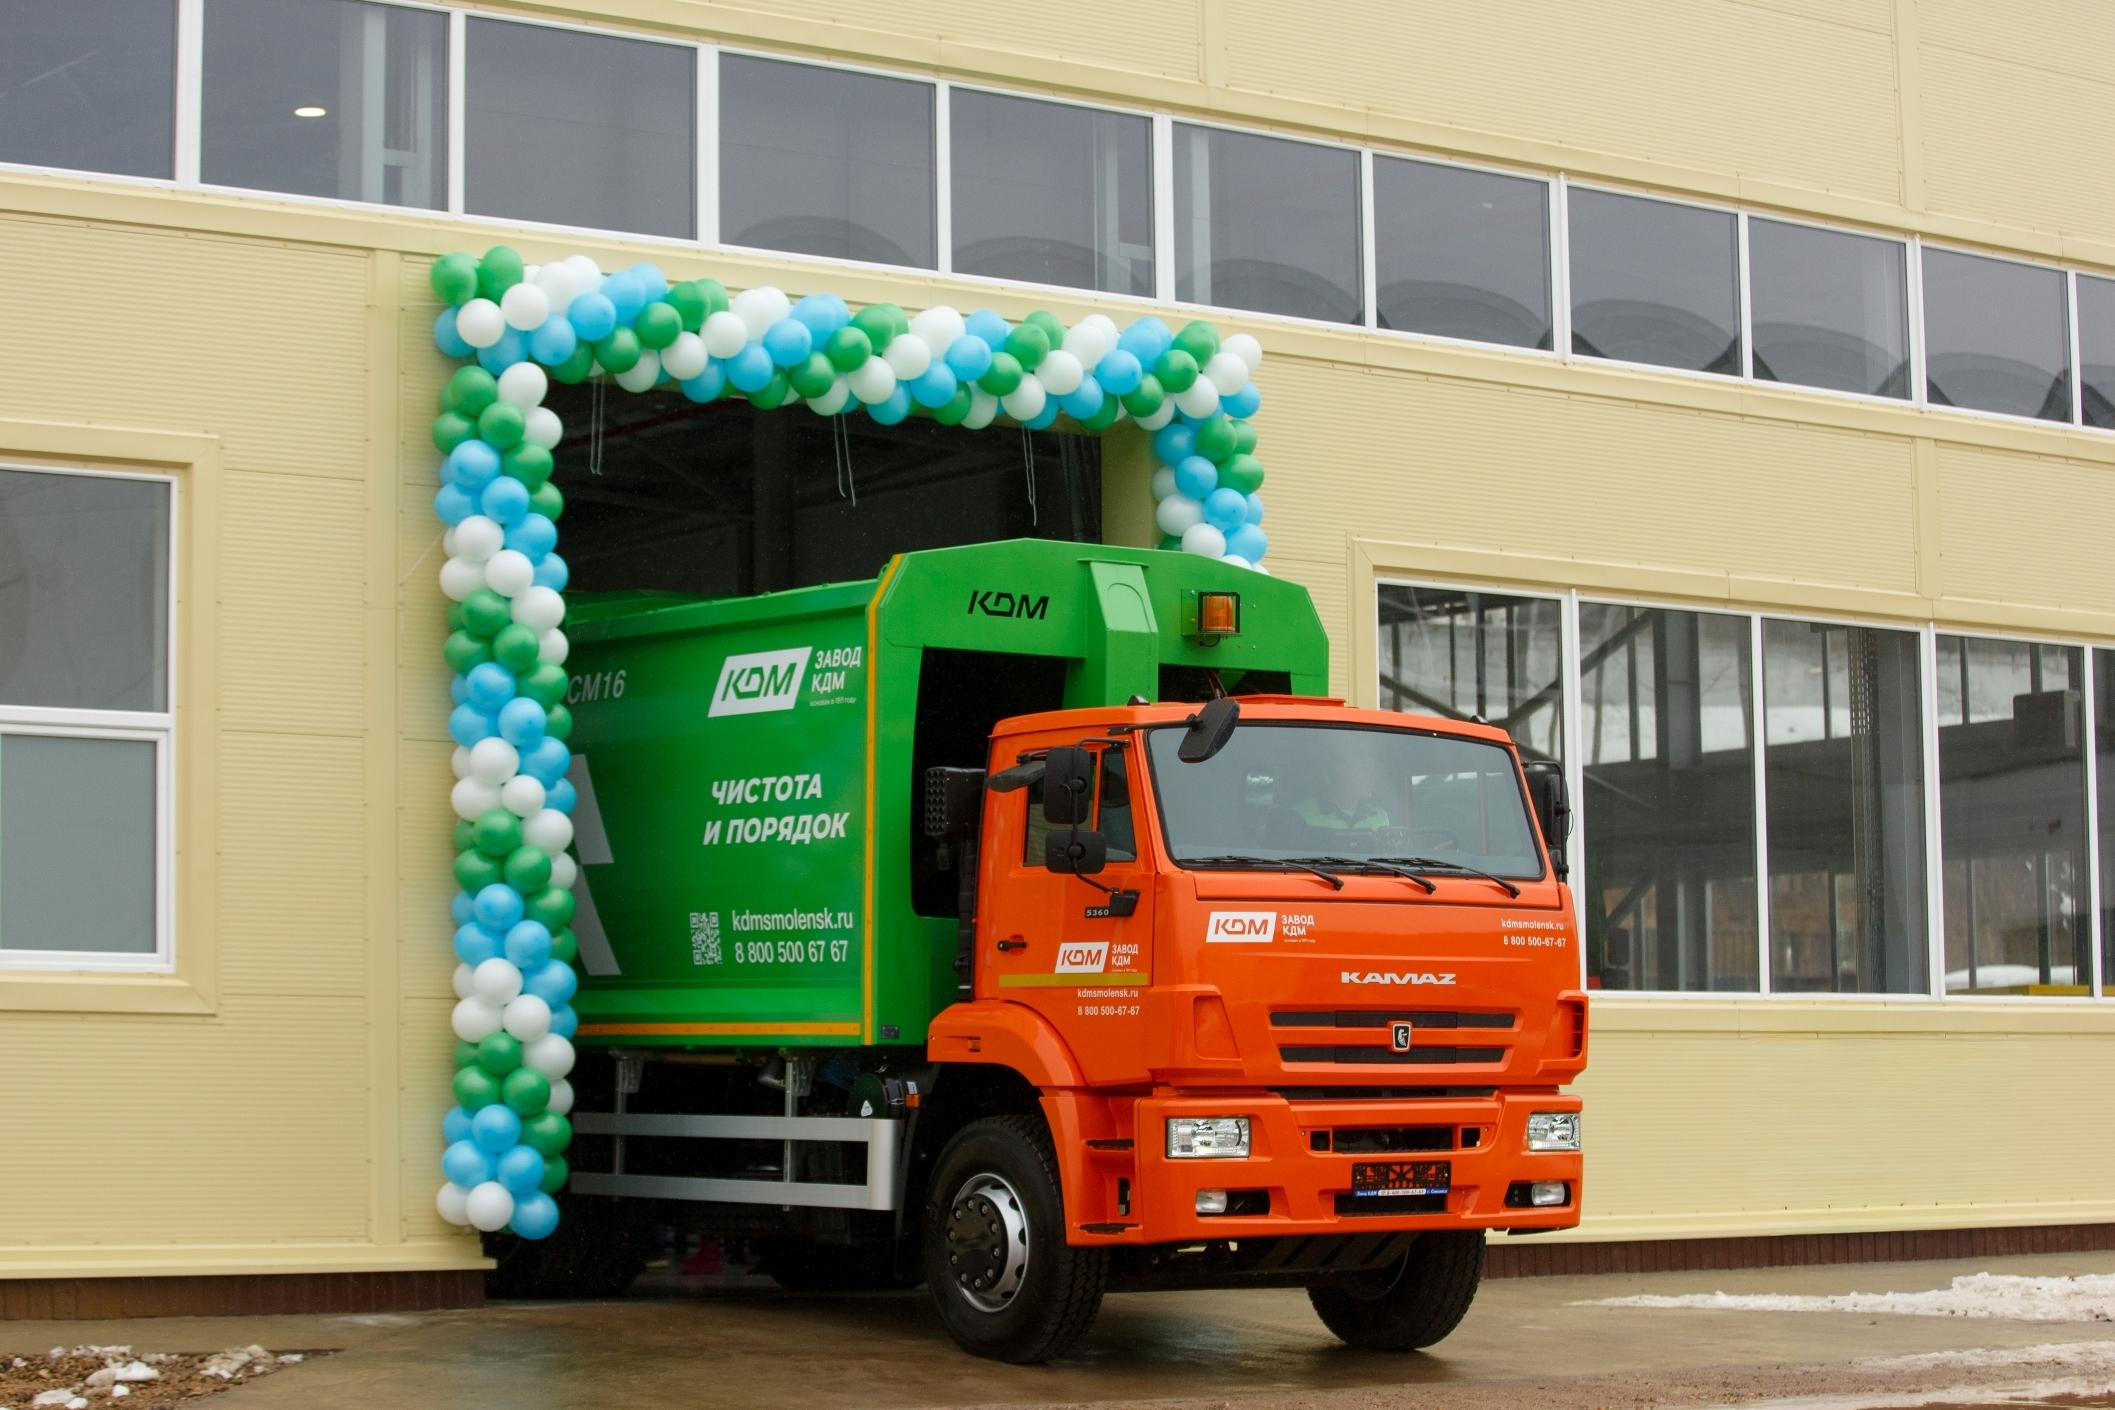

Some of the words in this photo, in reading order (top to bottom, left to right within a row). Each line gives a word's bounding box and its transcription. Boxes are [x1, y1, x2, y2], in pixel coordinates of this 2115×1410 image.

[967, 590, 1050, 620] KDM
[814, 646, 862, 669] ЗАВОД
[721, 661, 798, 702] KDM
[811, 671, 845, 694] КДМ
[711, 773, 822, 805] ЧИСТОТА
[702, 820, 722, 846] И
[725, 812, 850, 845] ПОРЯДОК
[731, 907, 853, 931] kdmsmolensk.ru
[1086, 909, 1109, 917] 5360
[1281, 914, 1315, 926] ЗАВОД
[1214, 918, 1269, 936] KDM
[1282, 925, 1306, 937] КДМ
[1501, 918, 1564, 931] kdmsmolensk.ru
[1112, 944, 1139, 955] ЗАВОД
[1503, 935, 1509, 946] 8
[1510, 935, 1526, 946] 800
[1527, 936, 1567, 948] 500-67-67
[734, 942, 744, 963] 8
[747, 941, 774, 963] 800
[777, 941, 804, 963] 500
[807, 940, 826, 962] 67
[830, 940, 849, 962] 67
[1061, 948, 1103, 967] KDM
[1111, 955, 1131, 966] КДМ
[1340, 971, 1457, 986] KAMAZ
[1077, 988, 1139, 998] kdmsmolensk.ru
[1077, 1006, 1083, 1016] 8
[1084, 1006, 1099, 1016] 800
[1100, 1005, 1140, 1016] 500-67-67
